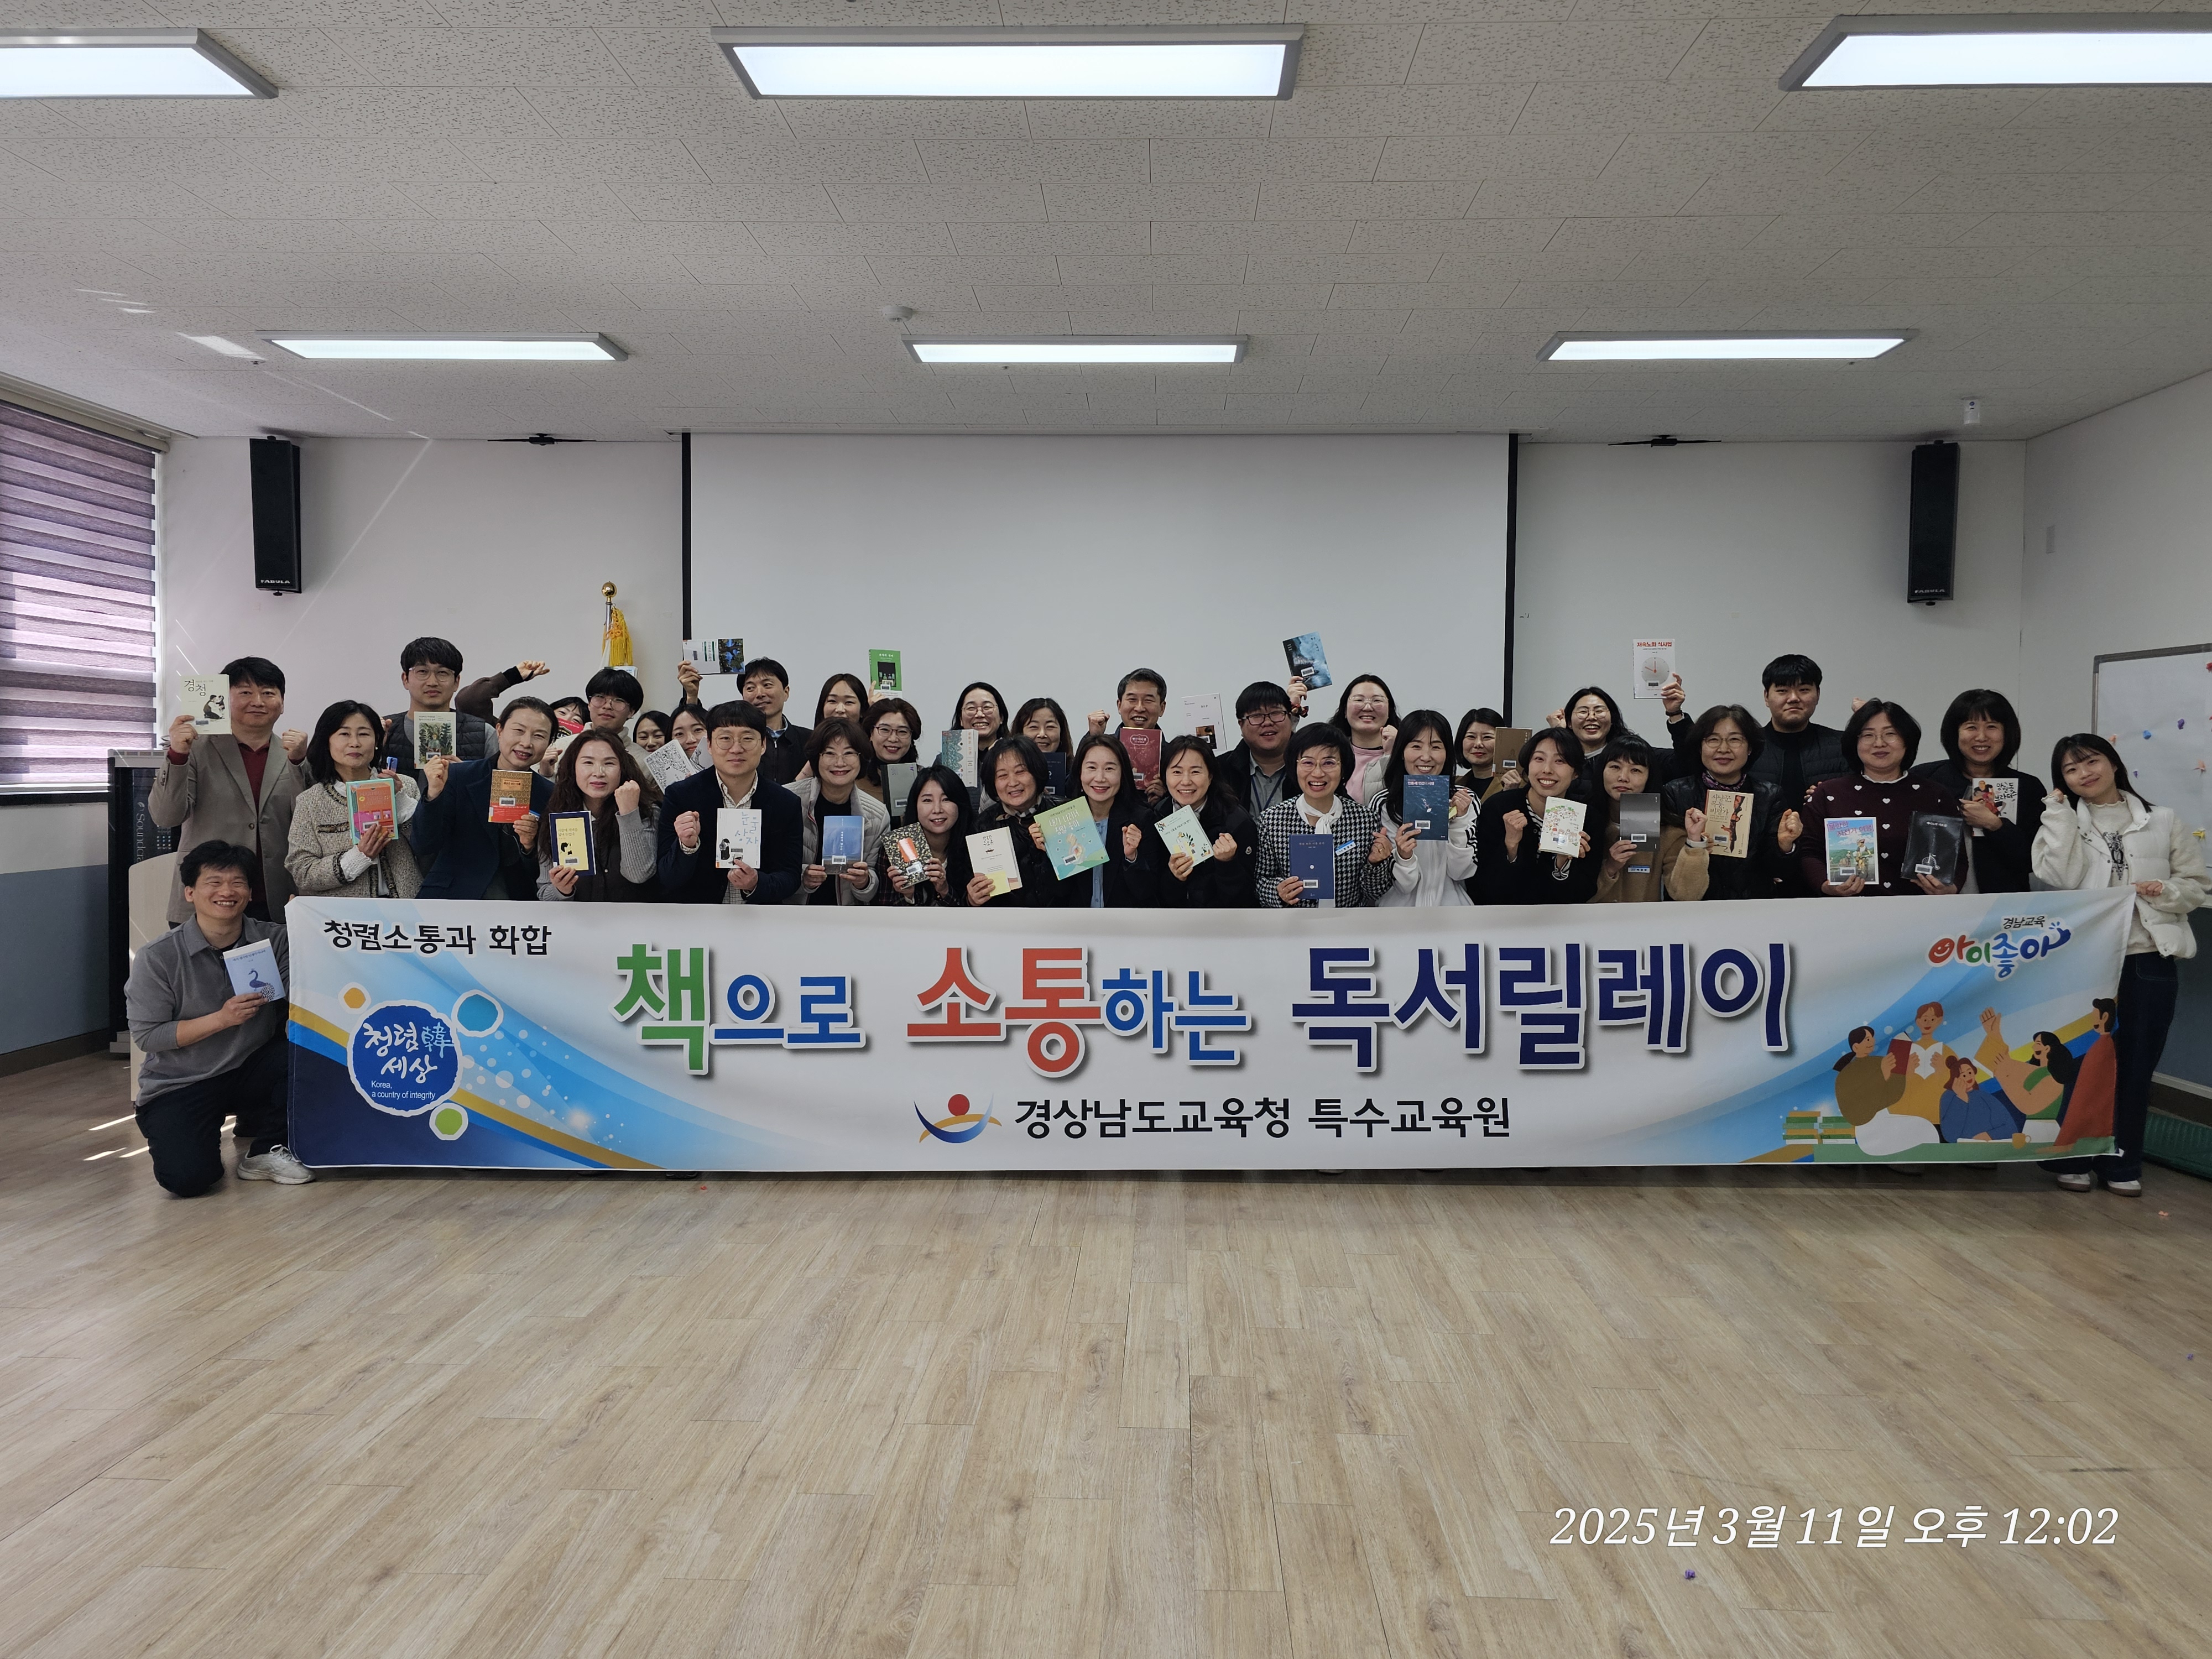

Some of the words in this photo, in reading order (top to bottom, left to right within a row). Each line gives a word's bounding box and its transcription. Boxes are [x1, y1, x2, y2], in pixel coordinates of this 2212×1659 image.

[184, 679, 206, 697] 경청
[1996, 781, 2015, 793] 망원동
[1994, 791, 2017, 802] 브라더스
[1048, 817, 1062, 828] 내가
[1062, 809, 1080, 822] 나라서
[1710, 807, 1729, 816] 비평가
[1055, 825, 1067, 835] 정말
[1068, 819, 1080, 830] 좋아
[136, 813, 146, 862] Soundcra
[734, 828, 759, 844] 상자
[2002, 916, 2046, 930] 경남교육
[324, 920, 476, 954] 청렴소통과
[489, 925, 552, 956] 화합
[1928, 927, 2071, 978] 아이좋아
[615, 943, 861, 1072] 책으로
[907, 947, 1248, 1073] 소통하는
[1291, 942, 1787, 1068] 독서릴레이
[380, 1054, 438, 1084] 세상
[371, 1080, 393, 1089] Korea,
[377, 1091, 400, 1100] country
[409, 1091, 436, 1100] integrity
[1014, 1097, 1290, 1139] 경상남도교육청
[1307, 1097, 1510, 1138] 특수교육원
